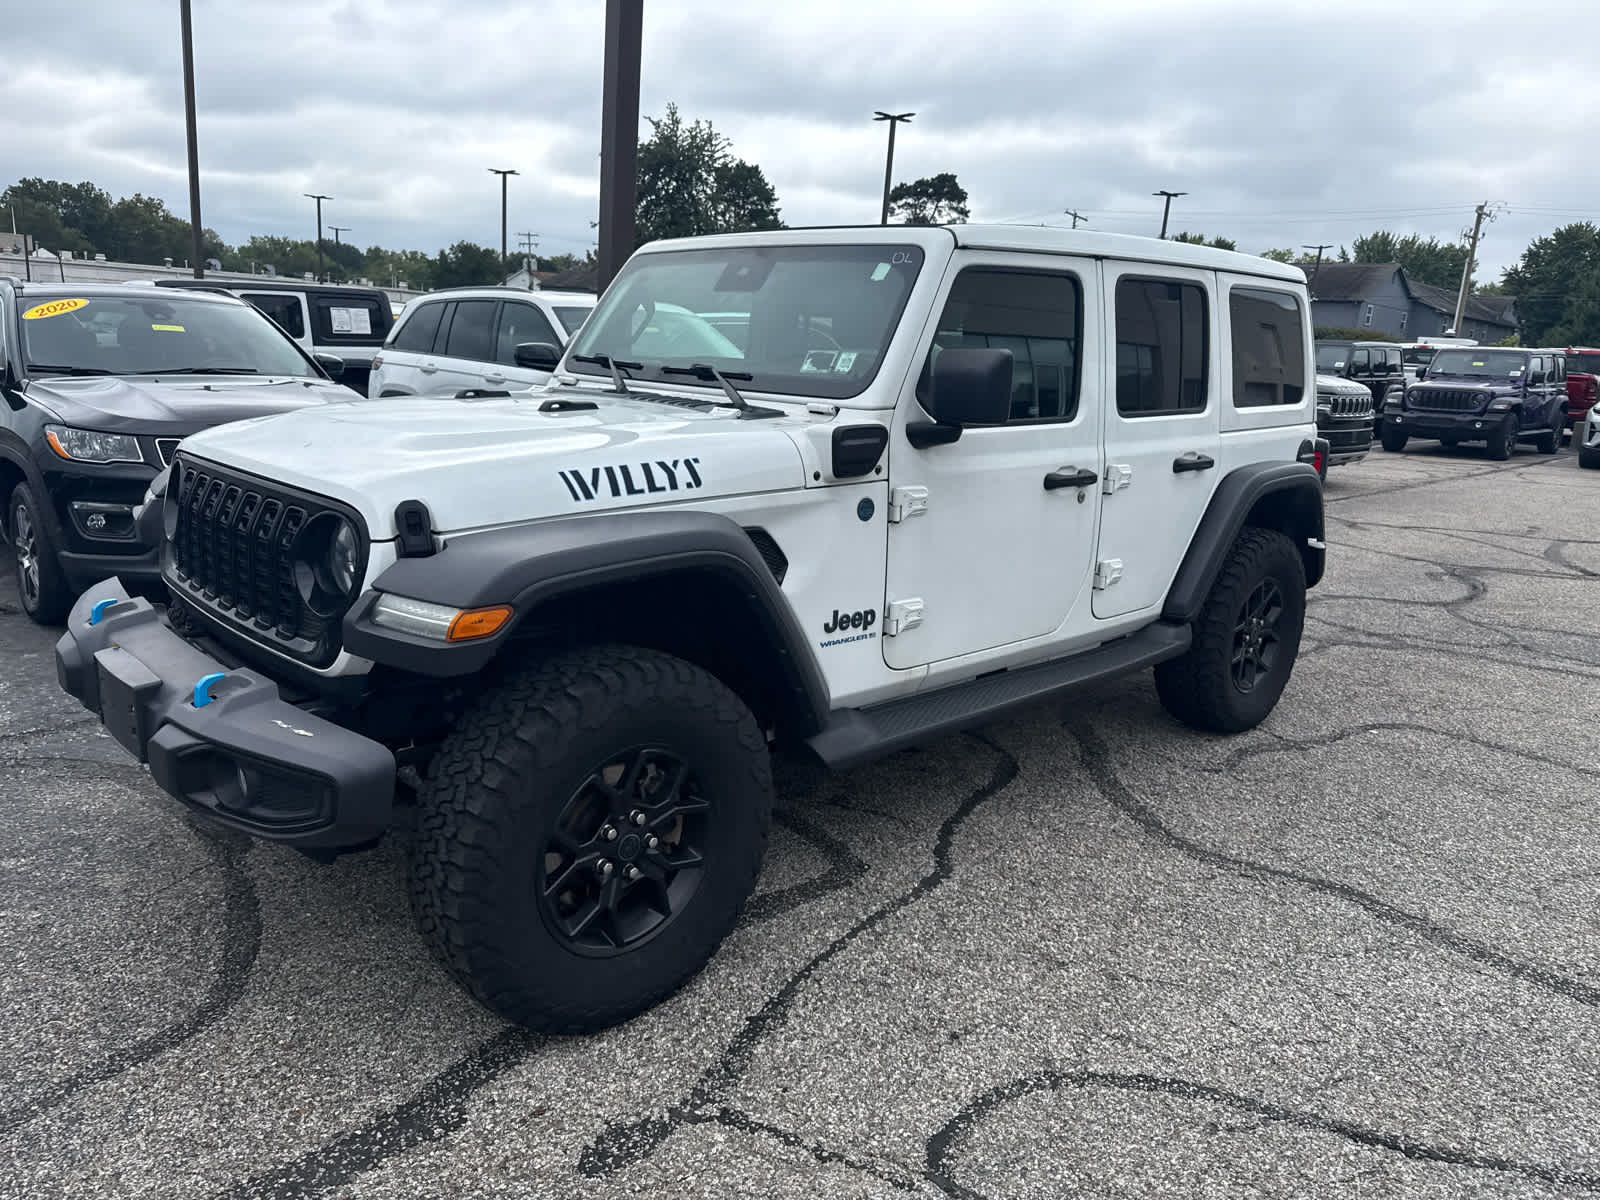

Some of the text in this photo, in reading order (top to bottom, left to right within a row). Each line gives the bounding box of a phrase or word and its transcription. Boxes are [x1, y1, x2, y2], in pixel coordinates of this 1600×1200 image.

[35, 300, 78, 317] 2020
[558, 457, 702, 502] WILLYS
[824, 609, 876, 634] Jeep
[820, 633, 868, 648] WRANGLER
